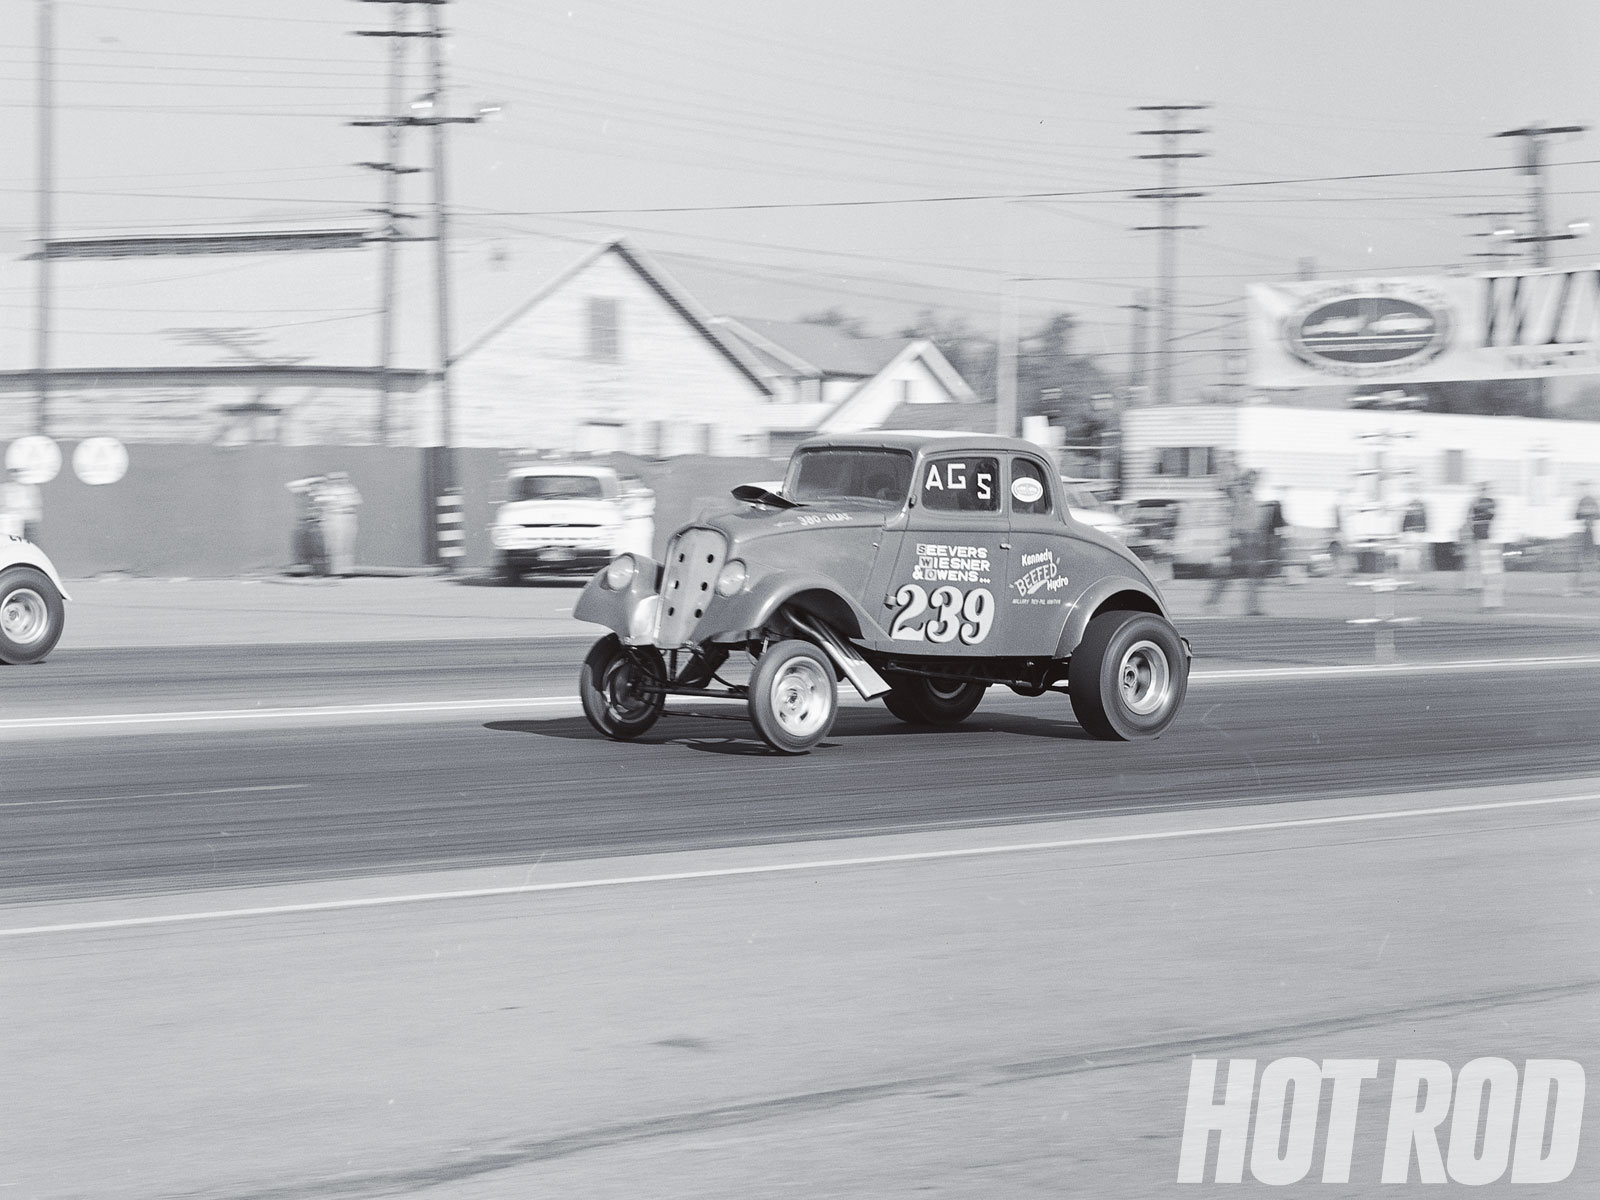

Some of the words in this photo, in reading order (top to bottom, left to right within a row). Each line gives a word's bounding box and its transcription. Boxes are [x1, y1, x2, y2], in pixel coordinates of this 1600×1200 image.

[916, 543, 988, 559] SEEVERS
[1021, 548, 1053, 567] Kennedy
[919, 556, 990, 572] WIESNER
[1046, 575, 1069, 592] Hydro
[889, 584, 995, 646] 239
